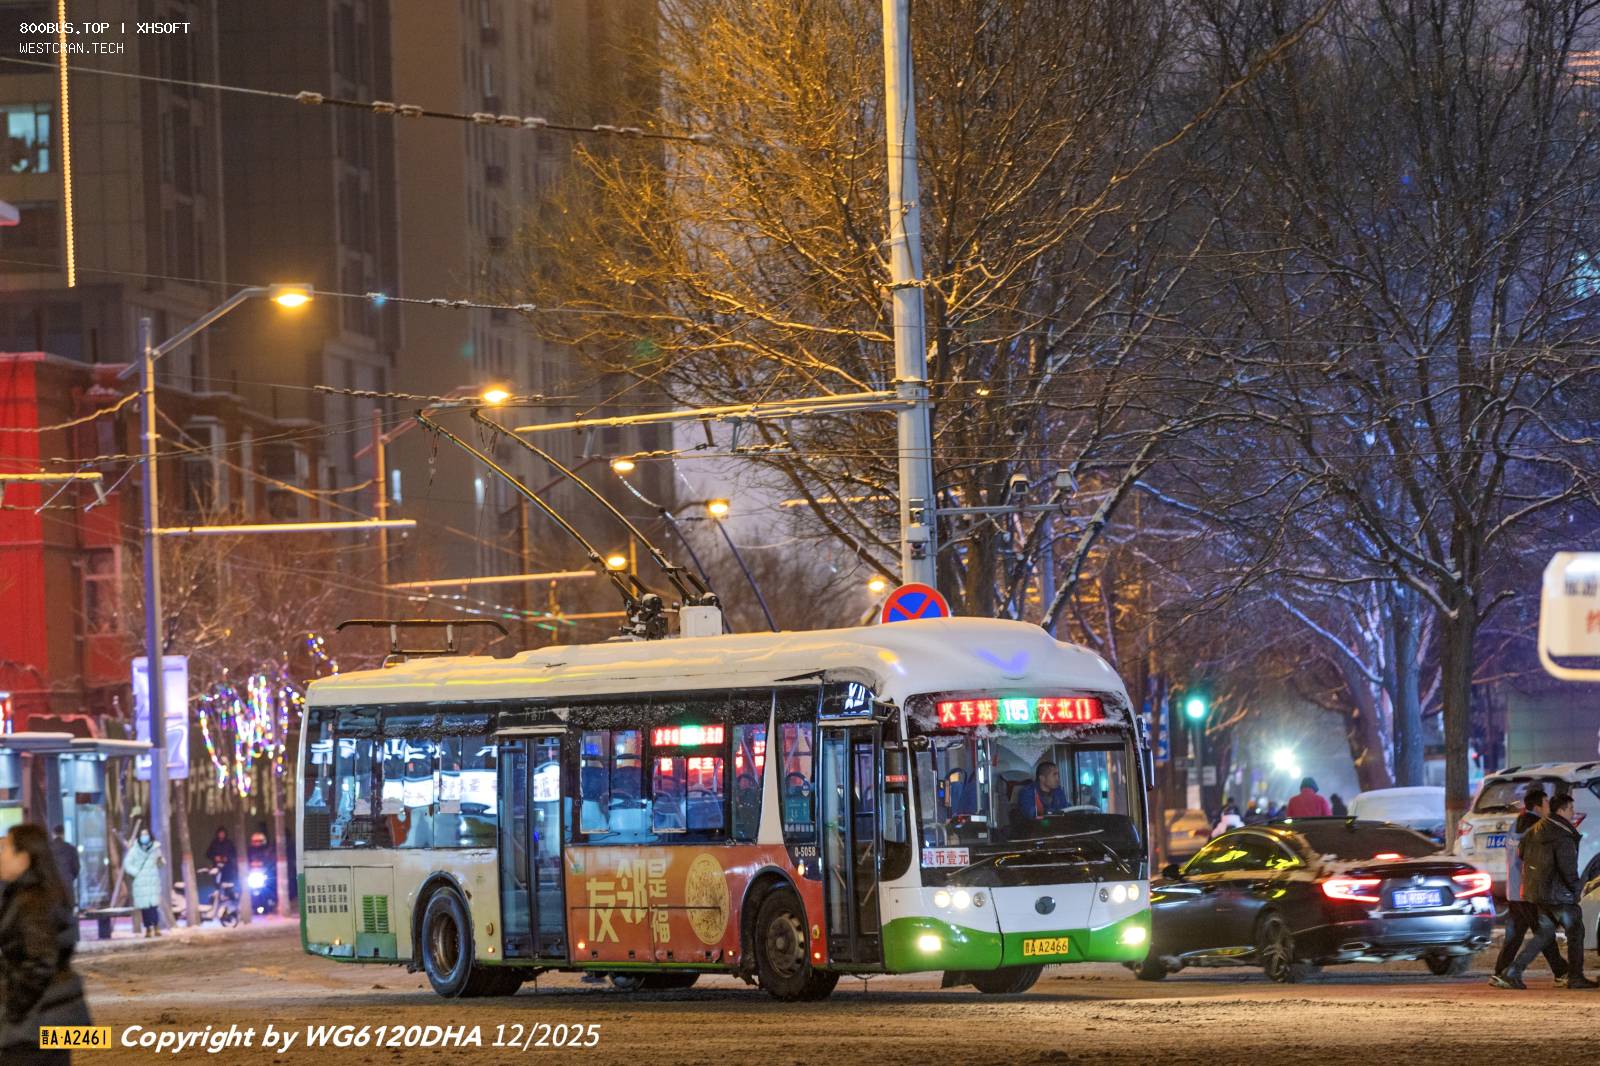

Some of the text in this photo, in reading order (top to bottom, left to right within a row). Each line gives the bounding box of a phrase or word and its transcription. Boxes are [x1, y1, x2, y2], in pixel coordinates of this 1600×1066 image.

[942, 701, 993, 723] 火车站
[1038, 698, 1091, 720] 大北门
[923, 850, 969, 865] 投币壹元
